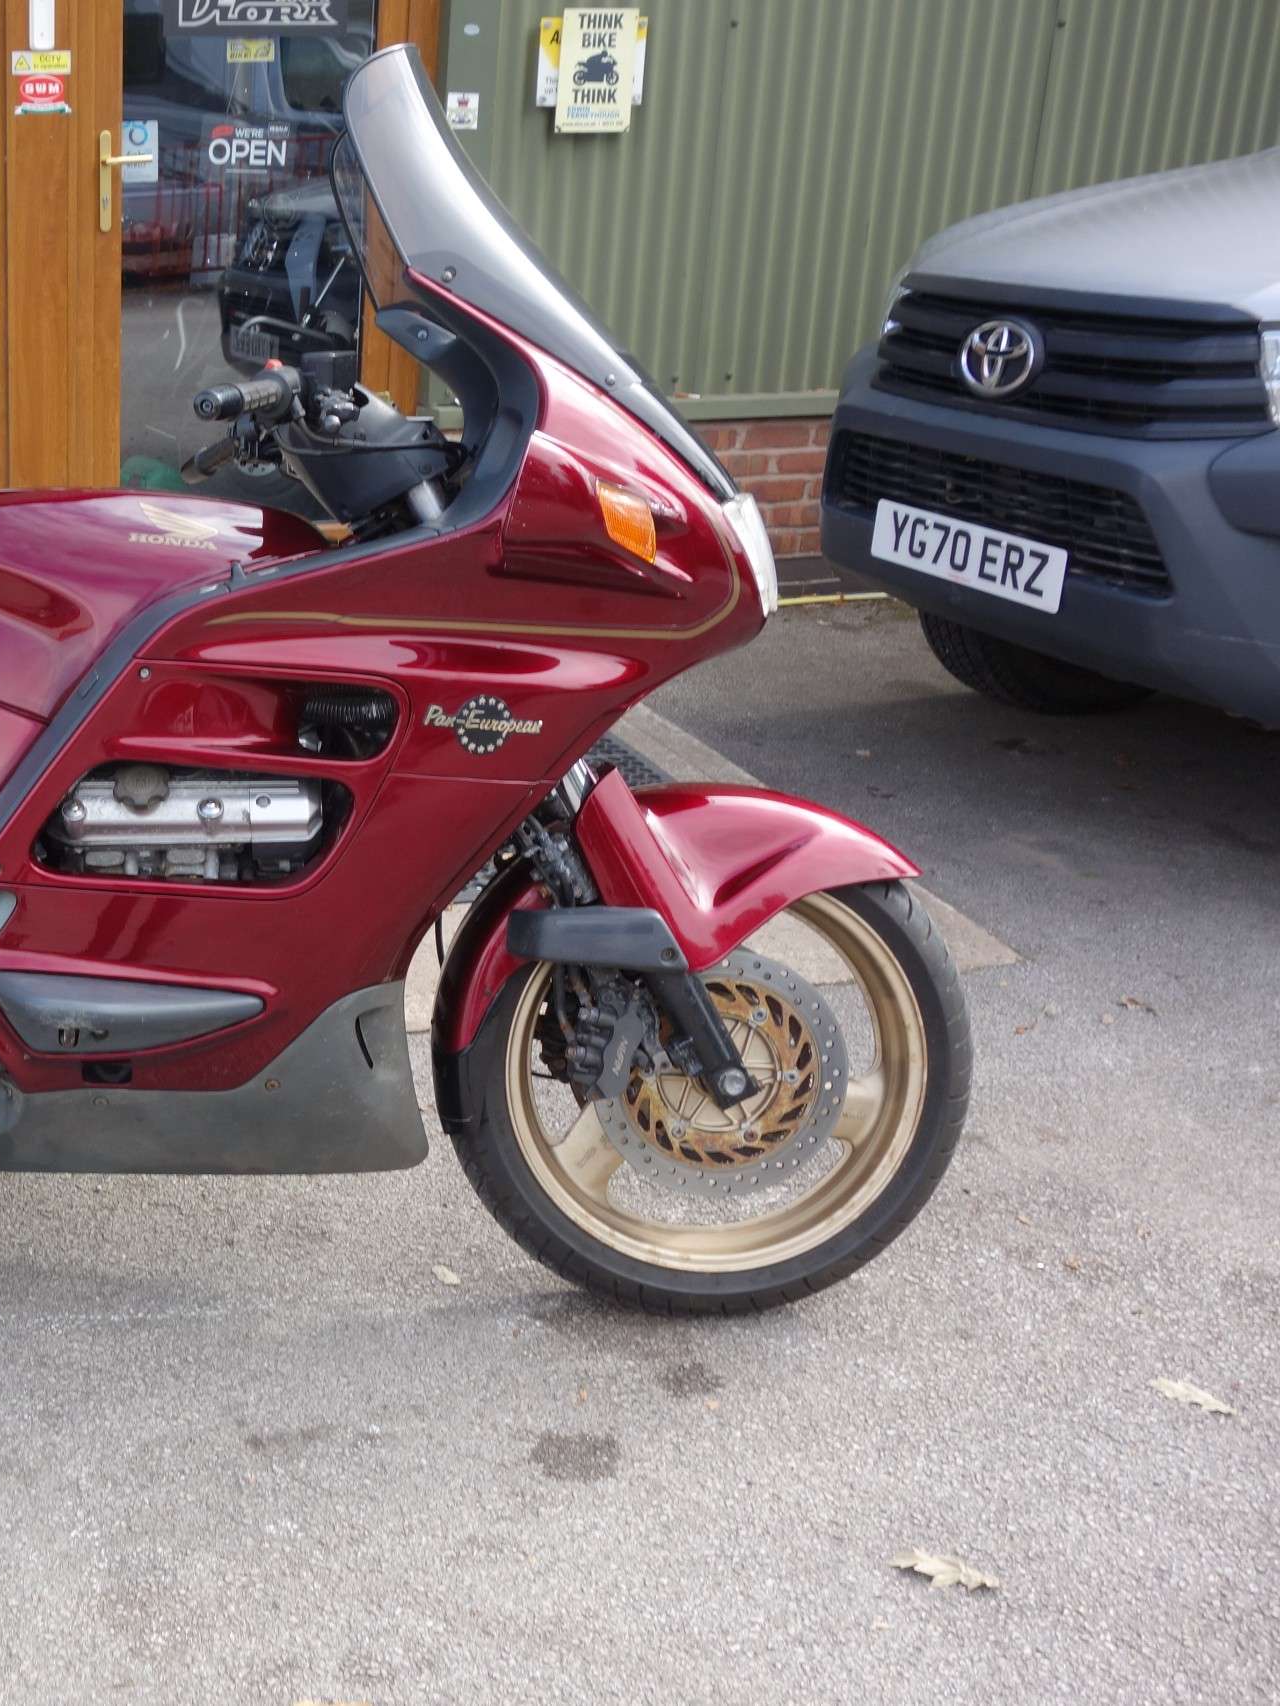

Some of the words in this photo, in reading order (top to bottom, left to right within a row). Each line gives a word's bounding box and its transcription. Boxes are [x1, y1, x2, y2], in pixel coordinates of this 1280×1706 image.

[578, 13, 624, 29] THINK
[582, 33, 617, 48] BIKE
[572, 88, 617, 104] THINK
[235, 127, 264, 139] WE'RE
[208, 138, 287, 167] OPEN
[128, 532, 218, 551] HONDA
[892, 510, 972, 572] YG70
[977, 536, 1050, 598] ERZ
